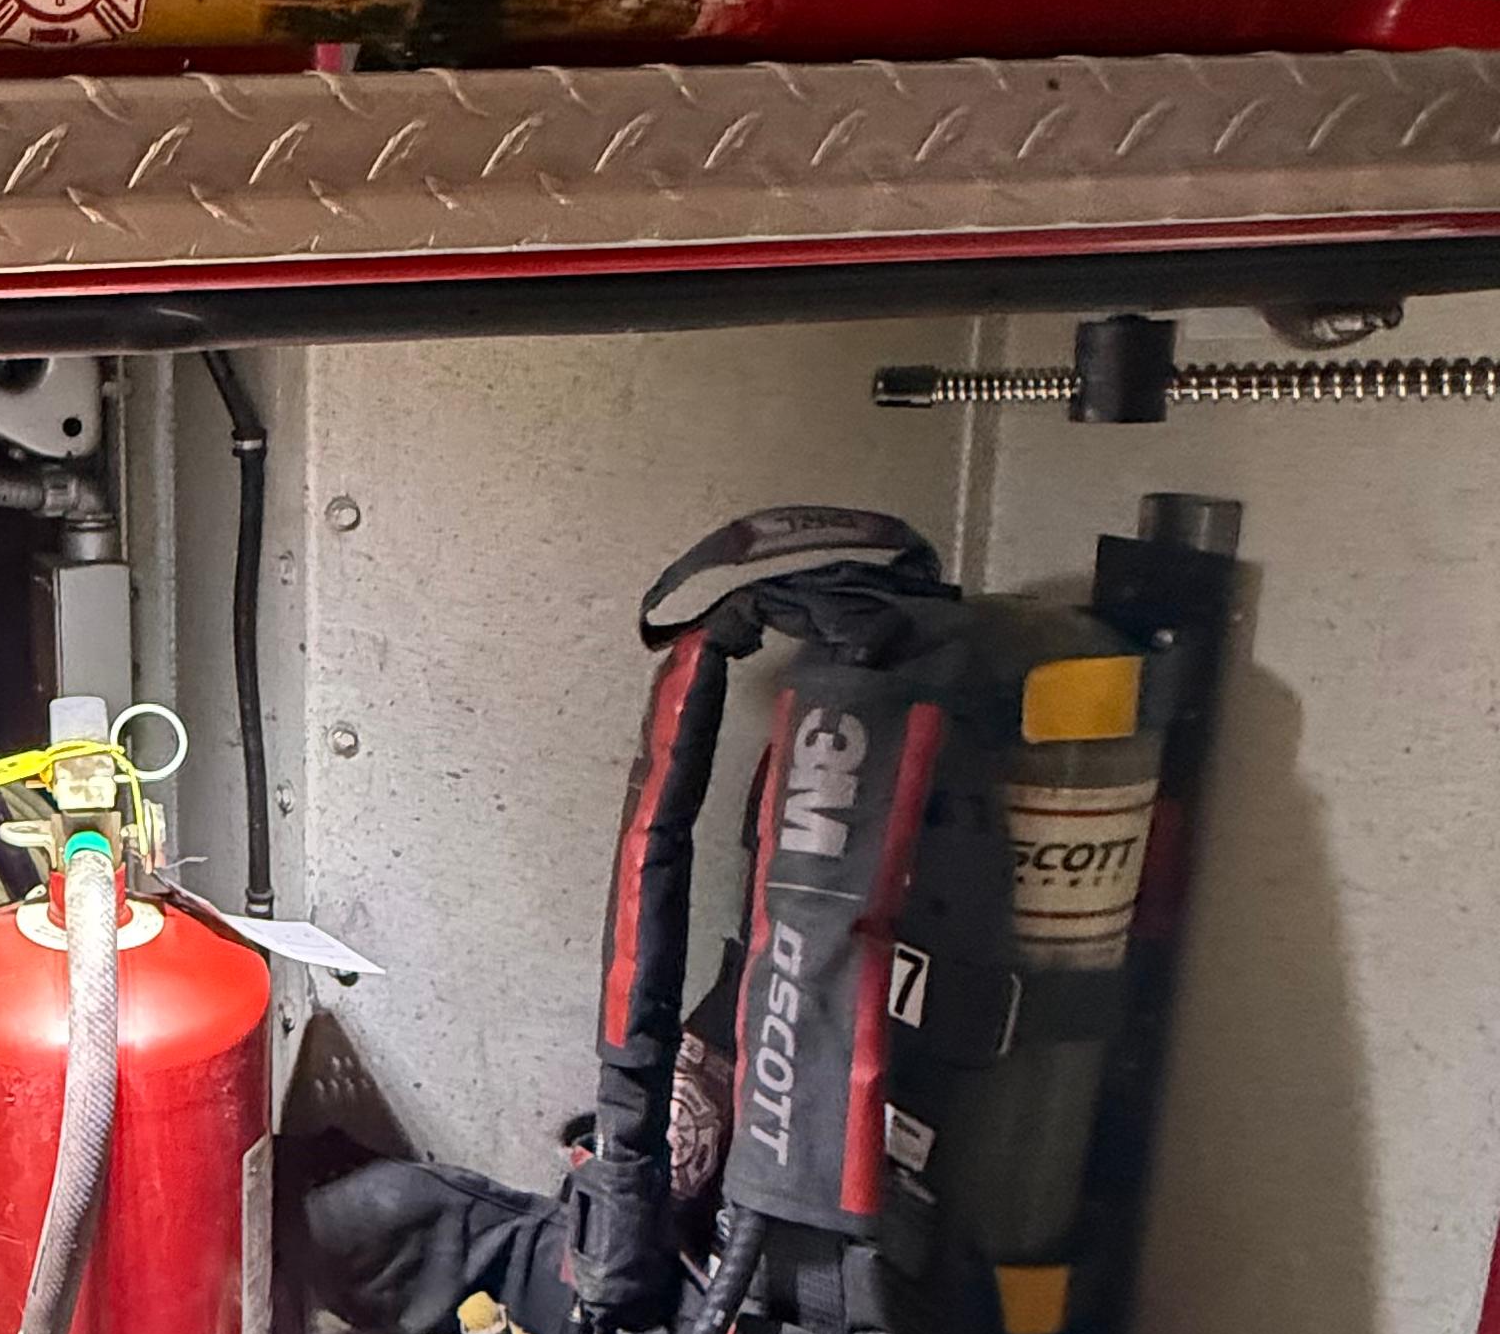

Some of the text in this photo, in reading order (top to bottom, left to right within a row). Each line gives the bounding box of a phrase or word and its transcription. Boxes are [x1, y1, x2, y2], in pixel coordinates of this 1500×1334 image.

[779, 707, 867, 857] 3M
[1009, 836, 1139, 872] SCOTT
[895, 947, 925, 1016] 7
[750, 977, 802, 1167] SCOTT
